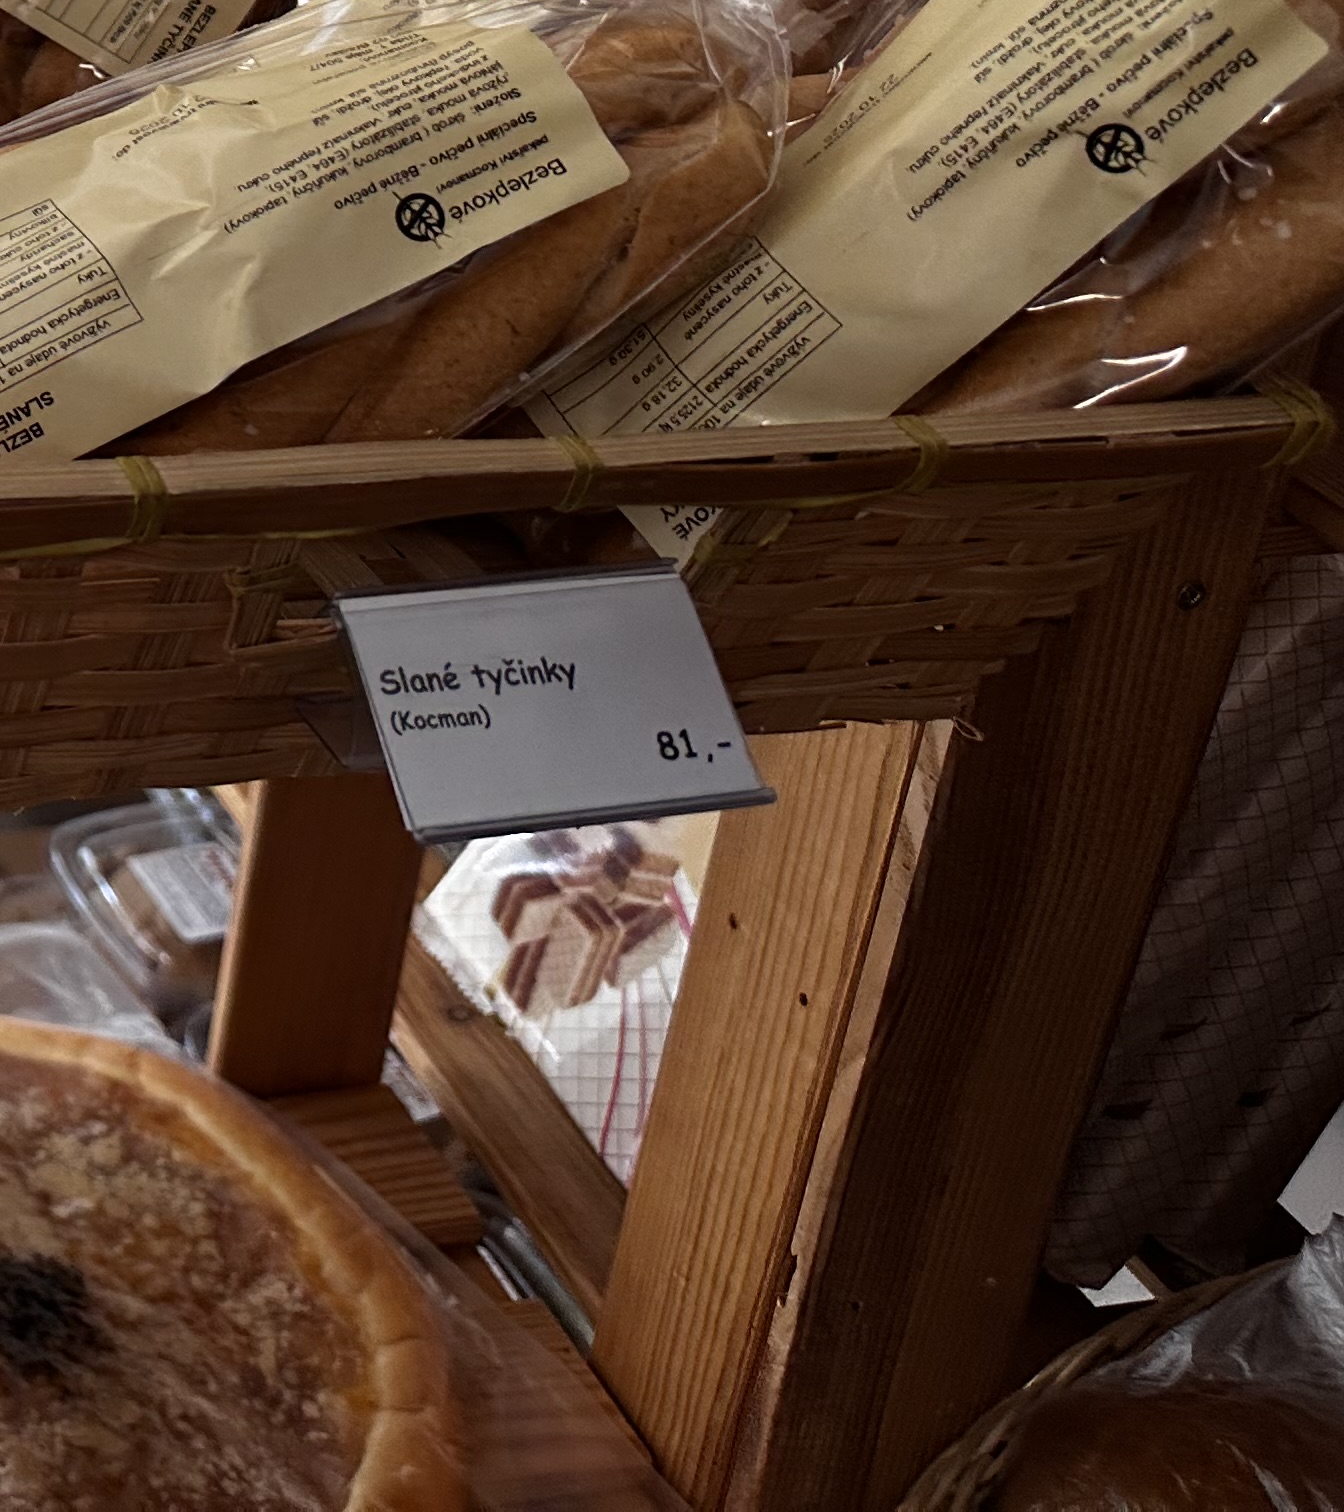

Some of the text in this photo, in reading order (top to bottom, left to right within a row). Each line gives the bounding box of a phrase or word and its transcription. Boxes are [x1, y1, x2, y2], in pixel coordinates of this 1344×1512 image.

[1101, 50, 1154, 97] pečivo
[468, 82, 523, 119] Složení:
[1138, 42, 1263, 148] Bezlepkové
[330, 105, 539, 215] Speciální pečivo Běžné pečivo
[444, 150, 568, 227] Bezlepkové
[74, 262, 107, 287] Tuky
[760, 277, 794, 309] Tuky
[743, 296, 814, 362] Energetycká
[5, 362, 25, 377] na
[703, 354, 750, 398] hodnota
[717, 330, 812, 416] výživové údaje na
[379, 656, 577, 696] Slané tyčinky
[390, 704, 492, 736] (Kocman)
[656, 727, 733, 765] 81,-
